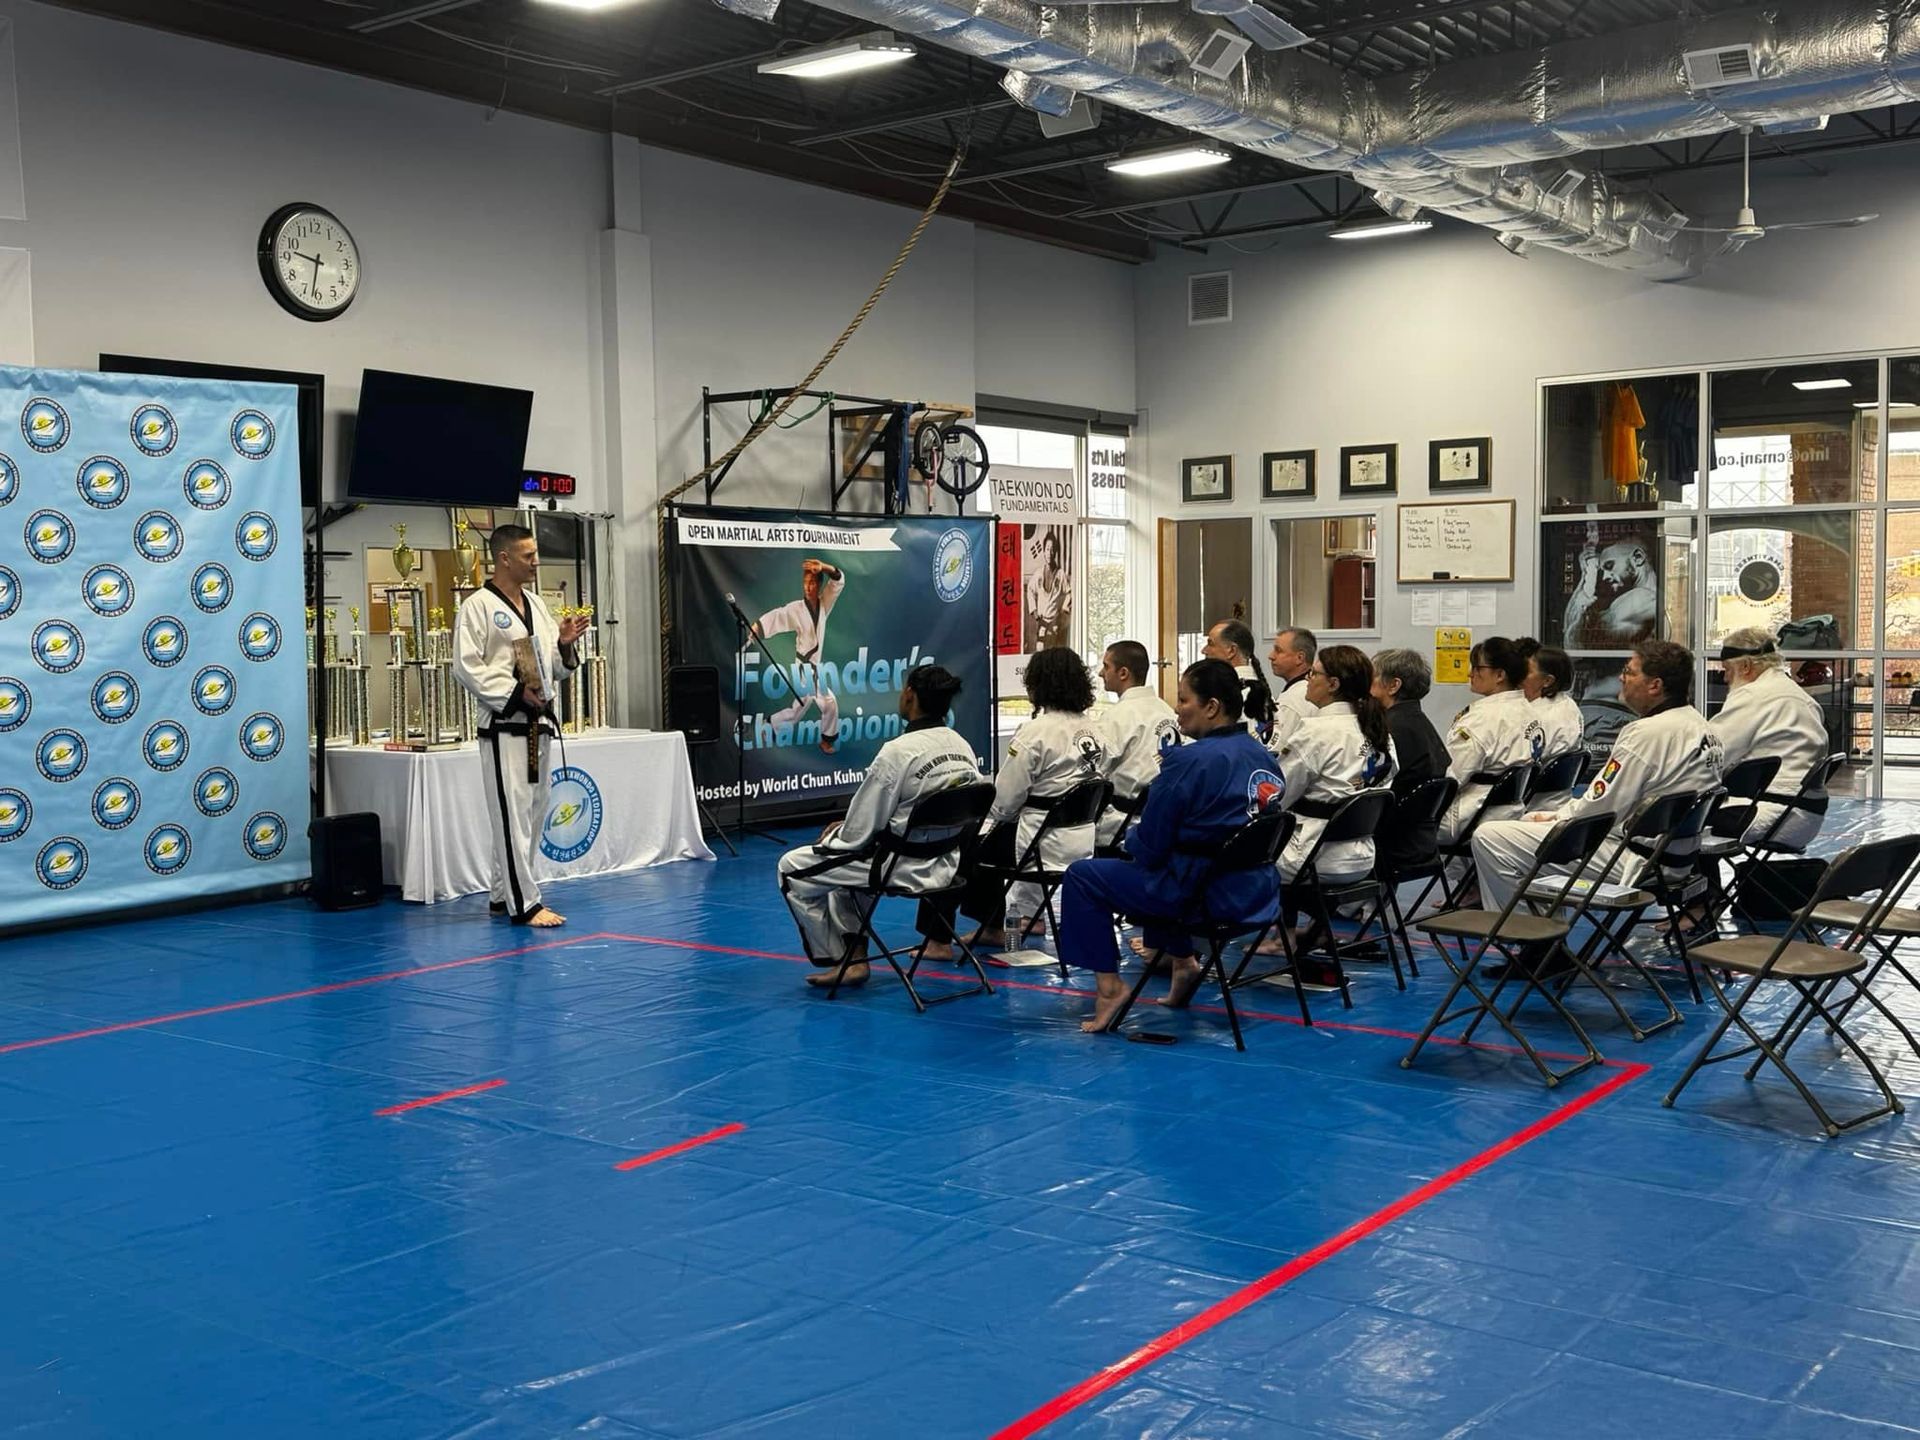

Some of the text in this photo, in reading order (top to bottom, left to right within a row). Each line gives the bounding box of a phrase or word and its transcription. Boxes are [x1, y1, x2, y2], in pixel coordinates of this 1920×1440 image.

[298, 226, 306, 238] 11
[310, 222, 320, 234] 12
[288, 237, 299, 250] 10
[336, 240, 343, 252] 2
[283, 251, 291, 263] 9
[343, 259, 349, 271] 3
[288, 269, 296, 281] 8
[338, 275, 345, 286] 4
[302, 283, 308, 294] 7
[314, 288, 322, 300] 6
[330, 286, 337, 297] 5
[990, 479, 1073, 499] TAEKWON DO
[1000, 499, 1068, 513] FUNDAMENTALS
[688, 524, 861, 546] OPEN MARTIAL ARTS TOURNAMENT
[734, 706, 955, 751] Champion
[697, 783, 740, 801] Hosted
[744, 780, 759, 798] by
[762, 775, 798, 794] World
[801, 772, 831, 789] Chun
[834, 769, 864, 786] Kuhn
